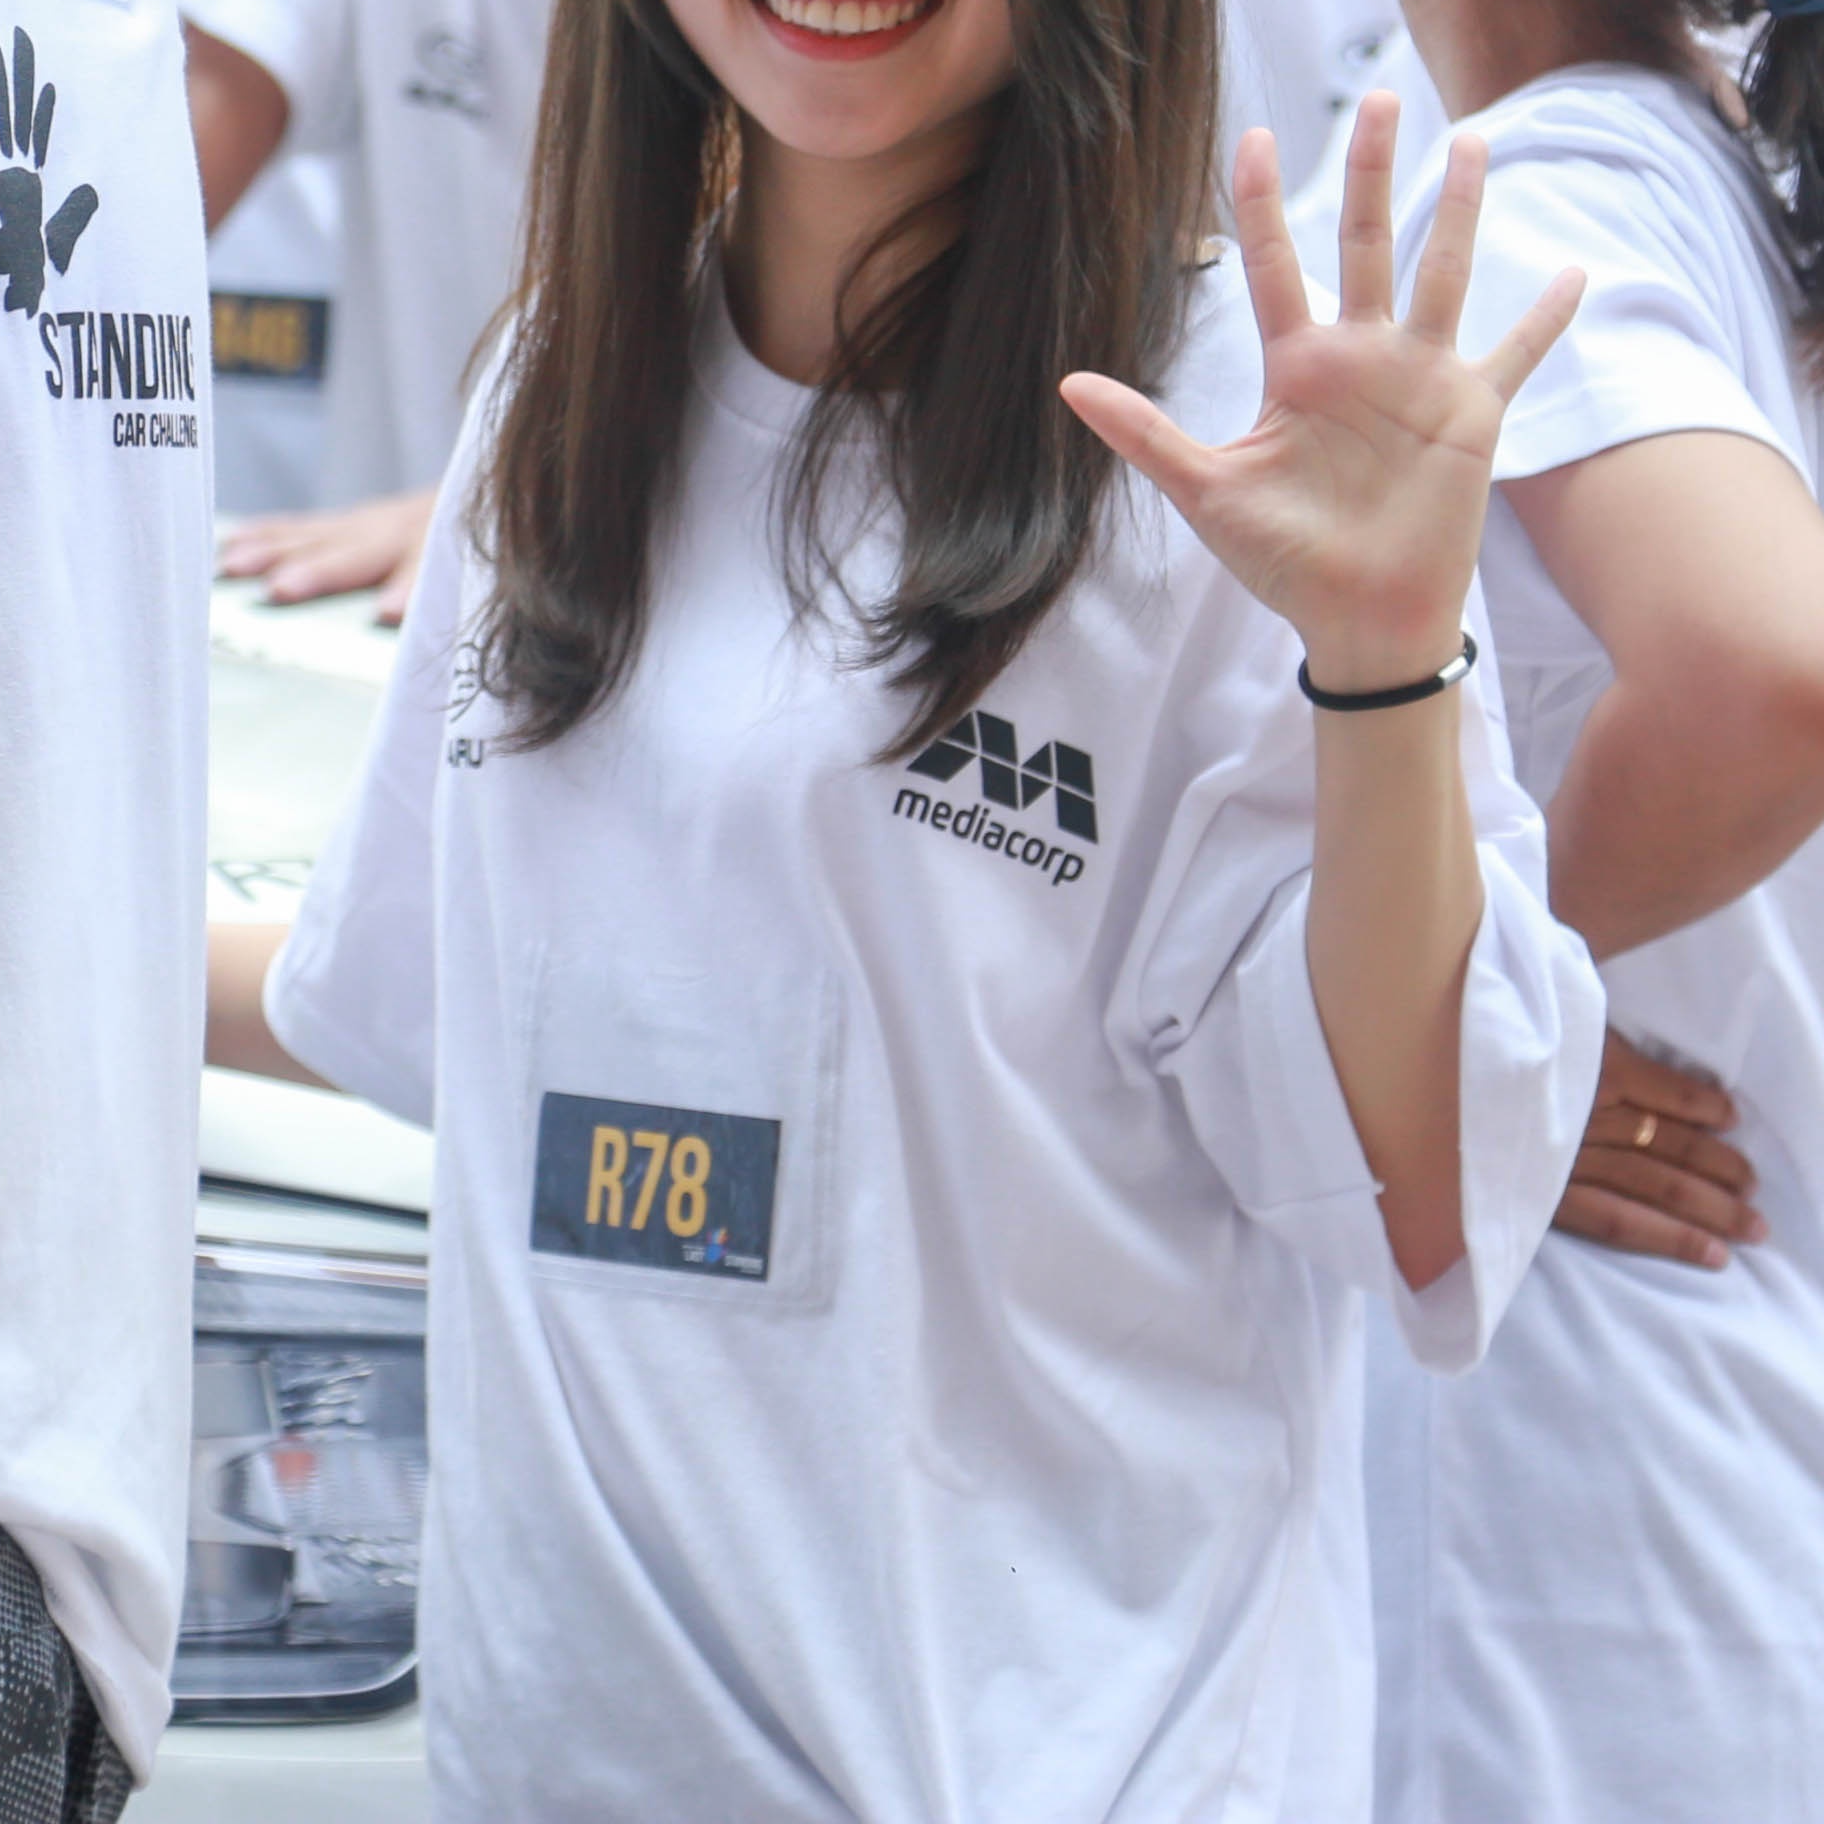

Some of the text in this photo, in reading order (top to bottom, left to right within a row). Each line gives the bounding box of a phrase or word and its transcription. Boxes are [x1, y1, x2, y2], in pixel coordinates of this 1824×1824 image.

[39, 311, 196, 402] STANDING
[113, 412, 146, 448] CAR
[892, 788, 1085, 887] mediacorp
[585, 1124, 712, 1238] R78
